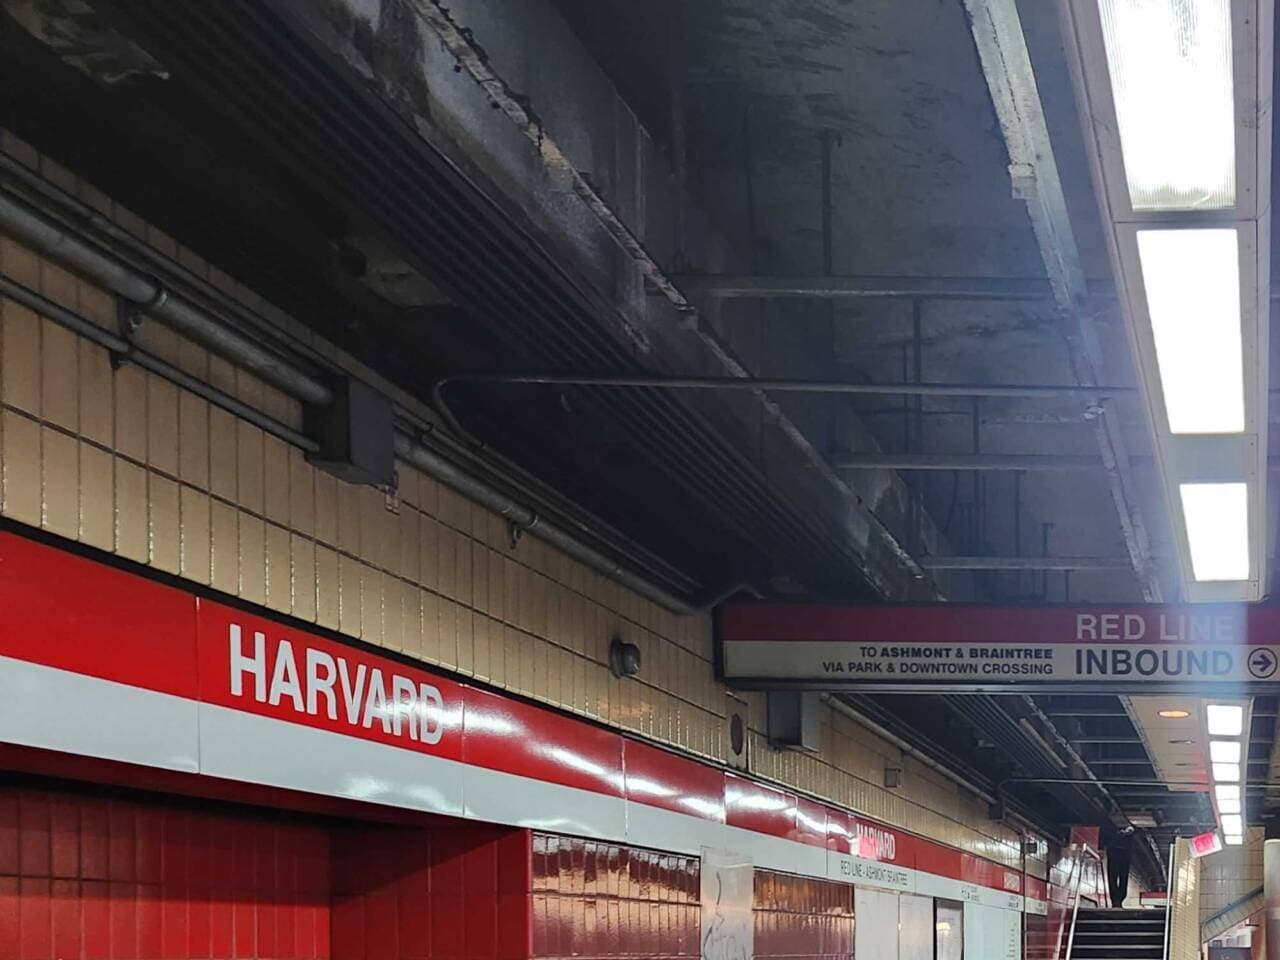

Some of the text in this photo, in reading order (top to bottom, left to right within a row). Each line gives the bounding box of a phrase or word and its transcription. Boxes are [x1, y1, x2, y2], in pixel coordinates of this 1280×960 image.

[1076, 614, 1234, 641] RED LINE
[860, 646, 1053, 659] TO ASHMONT & BRAINTREE
[1075, 649, 1234, 676] INBOUND
[822, 662, 1054, 675] VIA PARK & DOWNTOWN CROSSING
[229, 623, 444, 745] HARVARD
